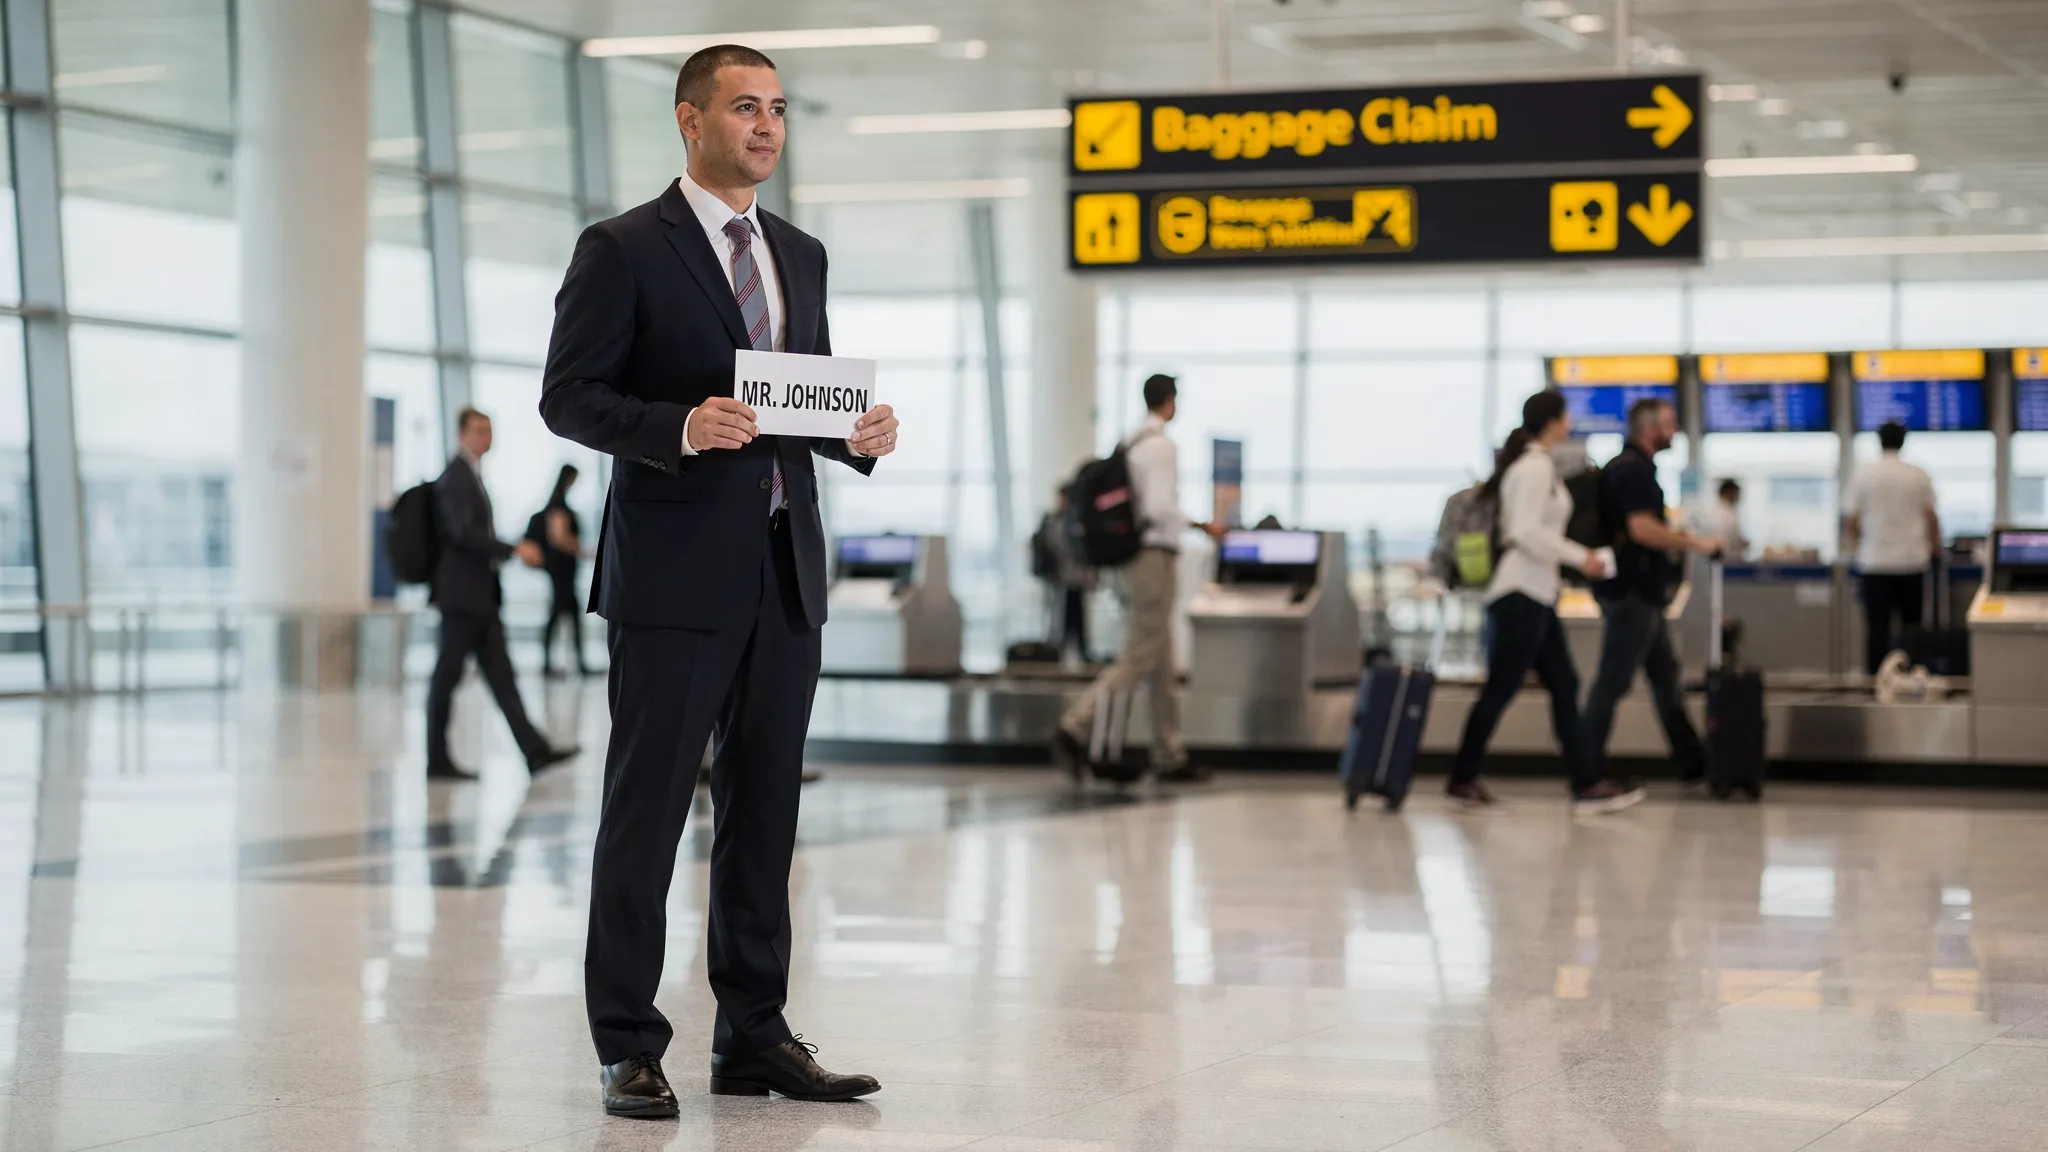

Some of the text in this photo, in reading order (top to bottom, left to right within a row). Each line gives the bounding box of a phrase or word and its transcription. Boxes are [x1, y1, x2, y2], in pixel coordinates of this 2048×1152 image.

[1152, 95, 1497, 160] Baggage Claim
[742, 380, 868, 413] MR. JOHNSON
